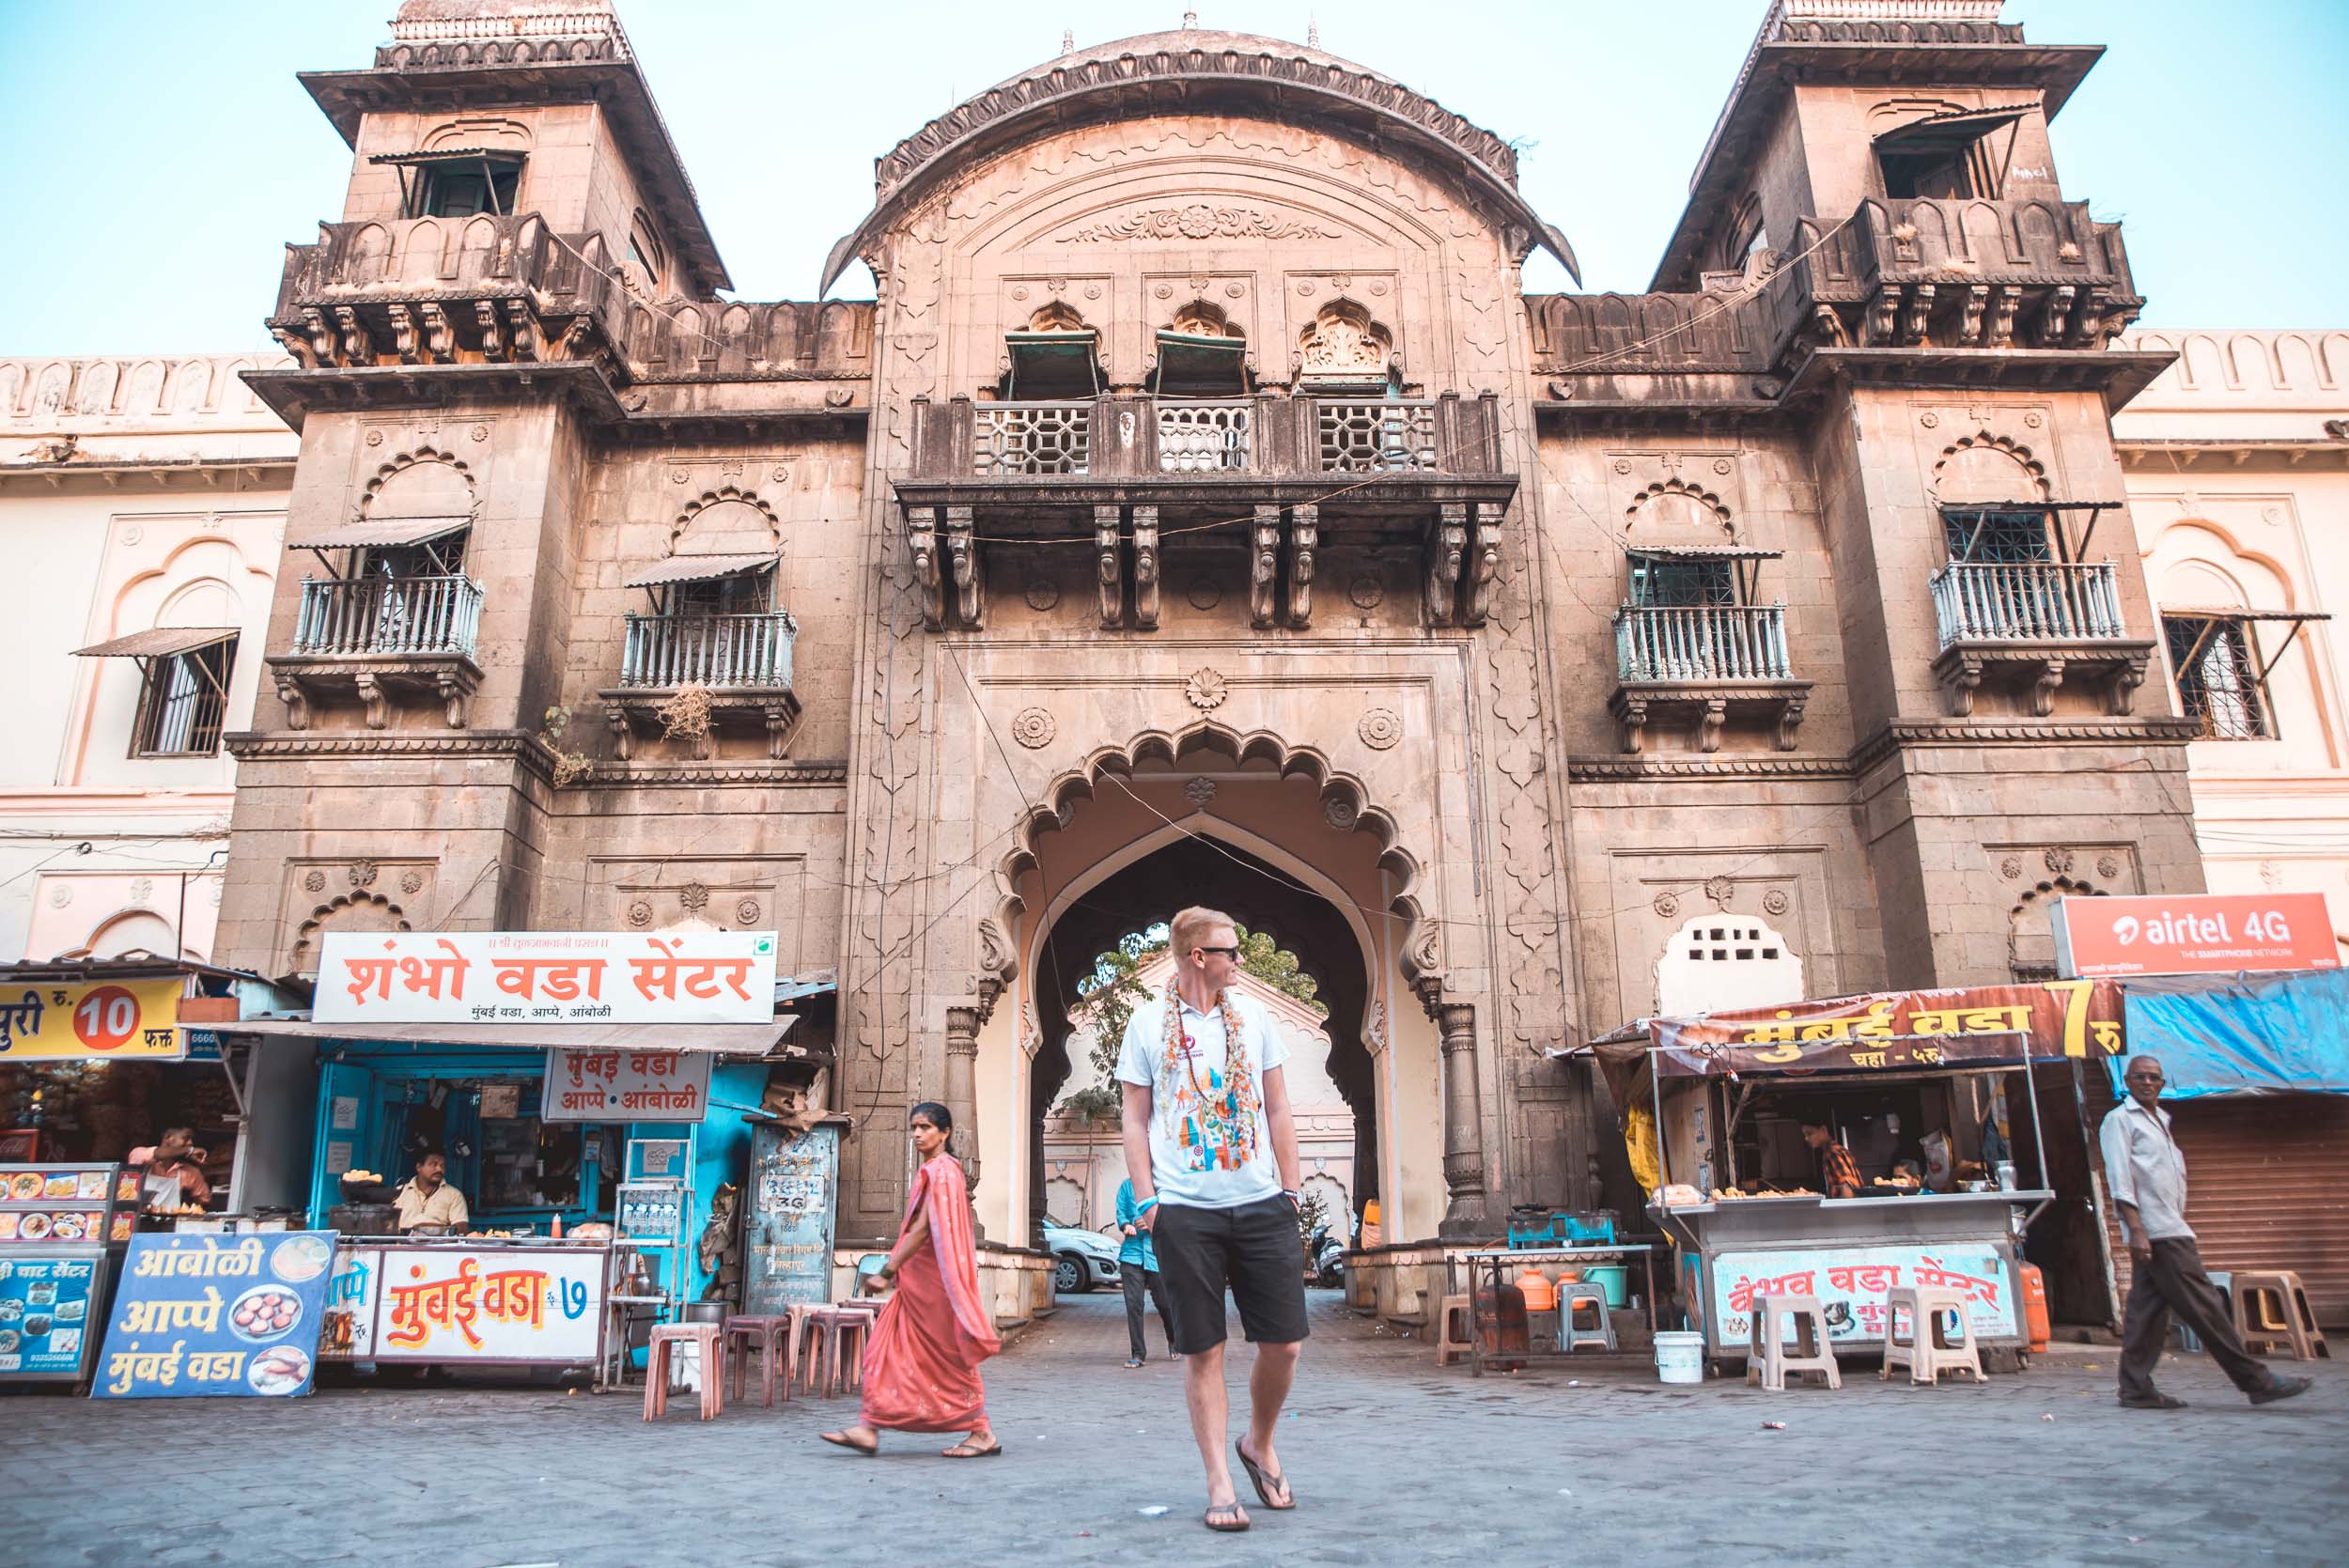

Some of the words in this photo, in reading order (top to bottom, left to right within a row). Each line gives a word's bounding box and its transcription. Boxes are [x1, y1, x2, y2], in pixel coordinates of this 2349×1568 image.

[2146, 910, 2232, 945] airtel
[2244, 911, 2291, 941] 4G
[344, 939, 472, 1006] शंभो
[491, 958, 609, 1001] वडा
[628, 938, 756, 1001] सेंटर
[2180, 951, 2197, 959] THE
[2197, 949, 2253, 959] SMARTPHONE
[2253, 948, 2294, 957] NETWORK
[80, 996, 135, 1037] 10
[471, 1004, 495, 1020] मुंबई
[500, 1007, 526, 1019] वडा,
[569, 1003, 612, 1018] आंबोळी
[1743, 1000, 1894, 1063] मुंबई
[1909, 1004, 2032, 1036] वडा
[2043, 979, 2094, 1058] 7
[630, 1051, 679, 1077] वडा
[1849, 1050, 1887, 1069] चहा
[621, 1083, 697, 1110] आंबोळी
[134, 1237, 265, 1279] आंबोळी
[1828, 1265, 1901, 1294] वडा
[119, 1285, 225, 1335] आप्पे
[386, 1257, 484, 1351] मुंबई
[484, 1269, 551, 1331] वडा
[560, 1277, 588, 1320] ७
[108, 1340, 187, 1395] मुंबई
[187, 1352, 247, 1382] वडा
